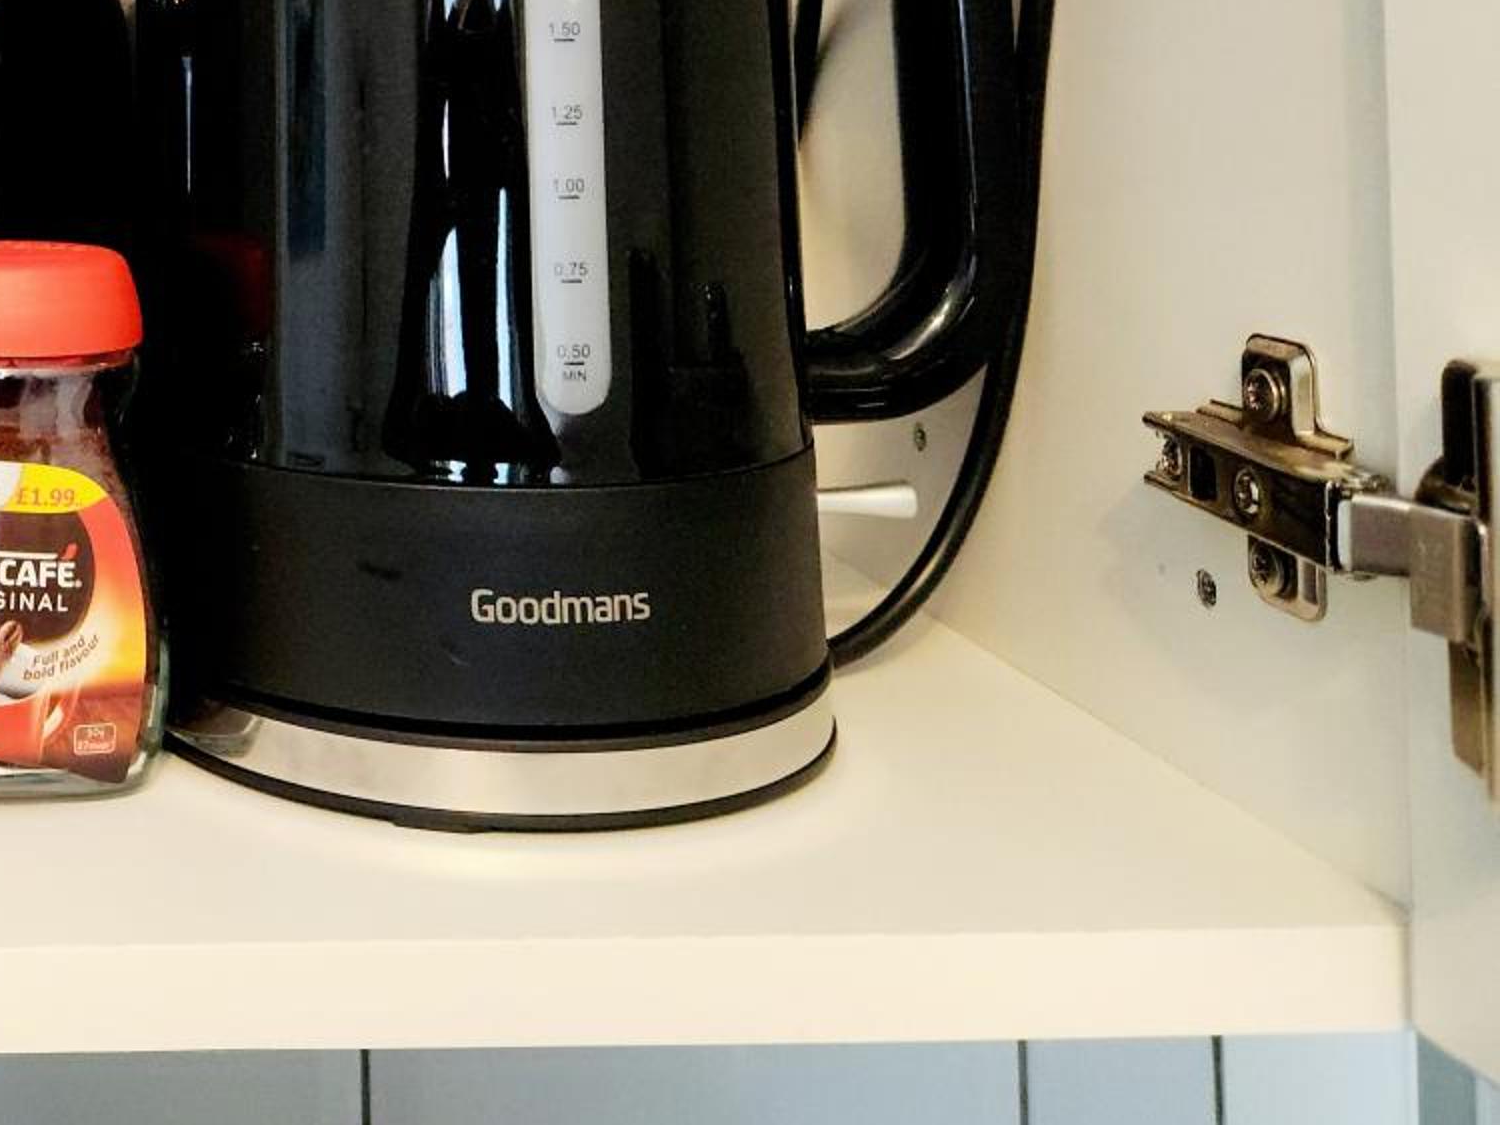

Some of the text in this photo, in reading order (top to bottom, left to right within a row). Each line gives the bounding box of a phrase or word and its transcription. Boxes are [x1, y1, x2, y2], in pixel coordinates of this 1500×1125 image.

[557, 345, 591, 358] 0.50
[563, 370, 587, 382] MIN
[16, 487, 75, 507] £1.99
[471, 589, 651, 624] Goodmans
[23, 635, 99, 681] bold flavour
[33, 635, 85, 667] Full and
